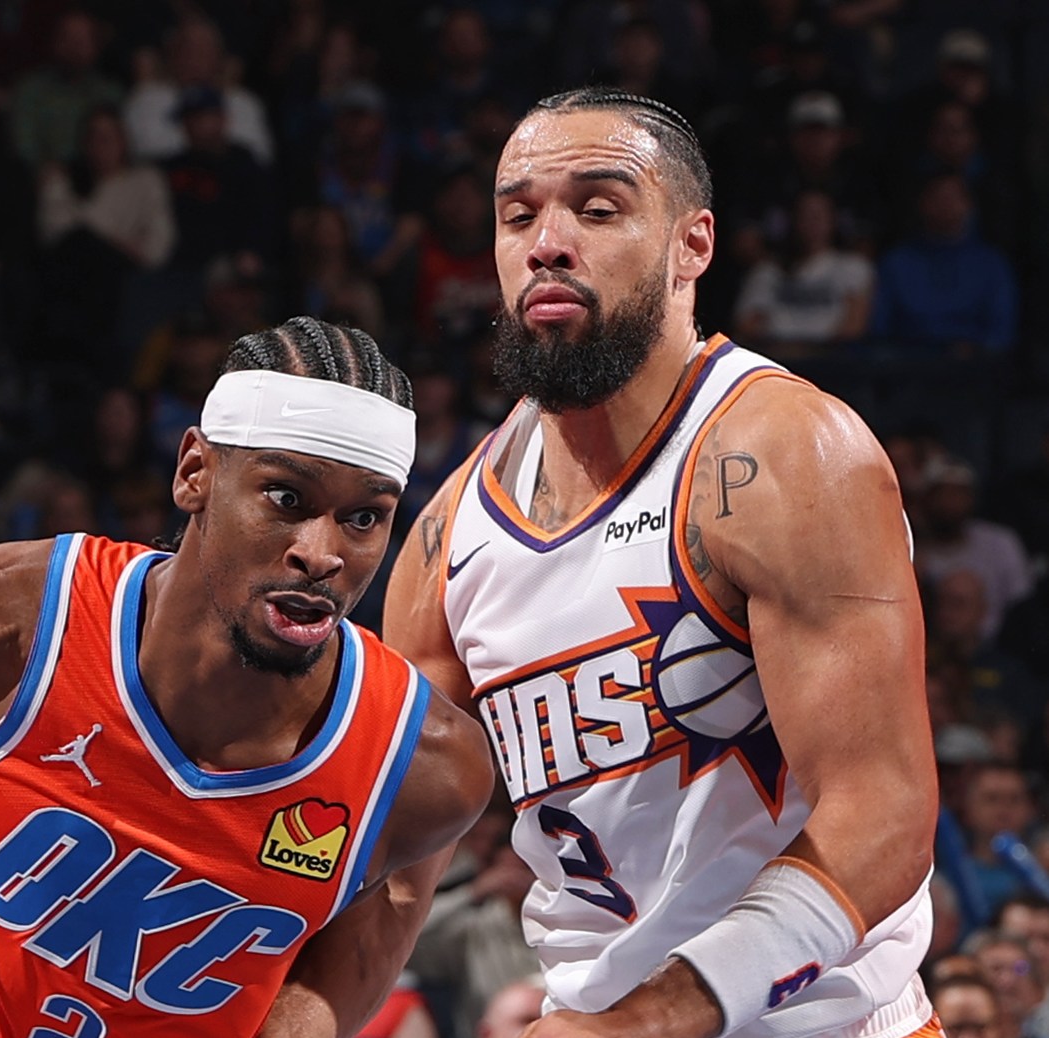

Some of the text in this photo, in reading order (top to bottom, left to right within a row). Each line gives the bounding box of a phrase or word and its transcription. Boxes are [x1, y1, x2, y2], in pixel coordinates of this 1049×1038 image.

[604, 506, 666, 543] PayPal
[478, 648, 651, 804] UNS
[538, 804, 638, 925] 3
